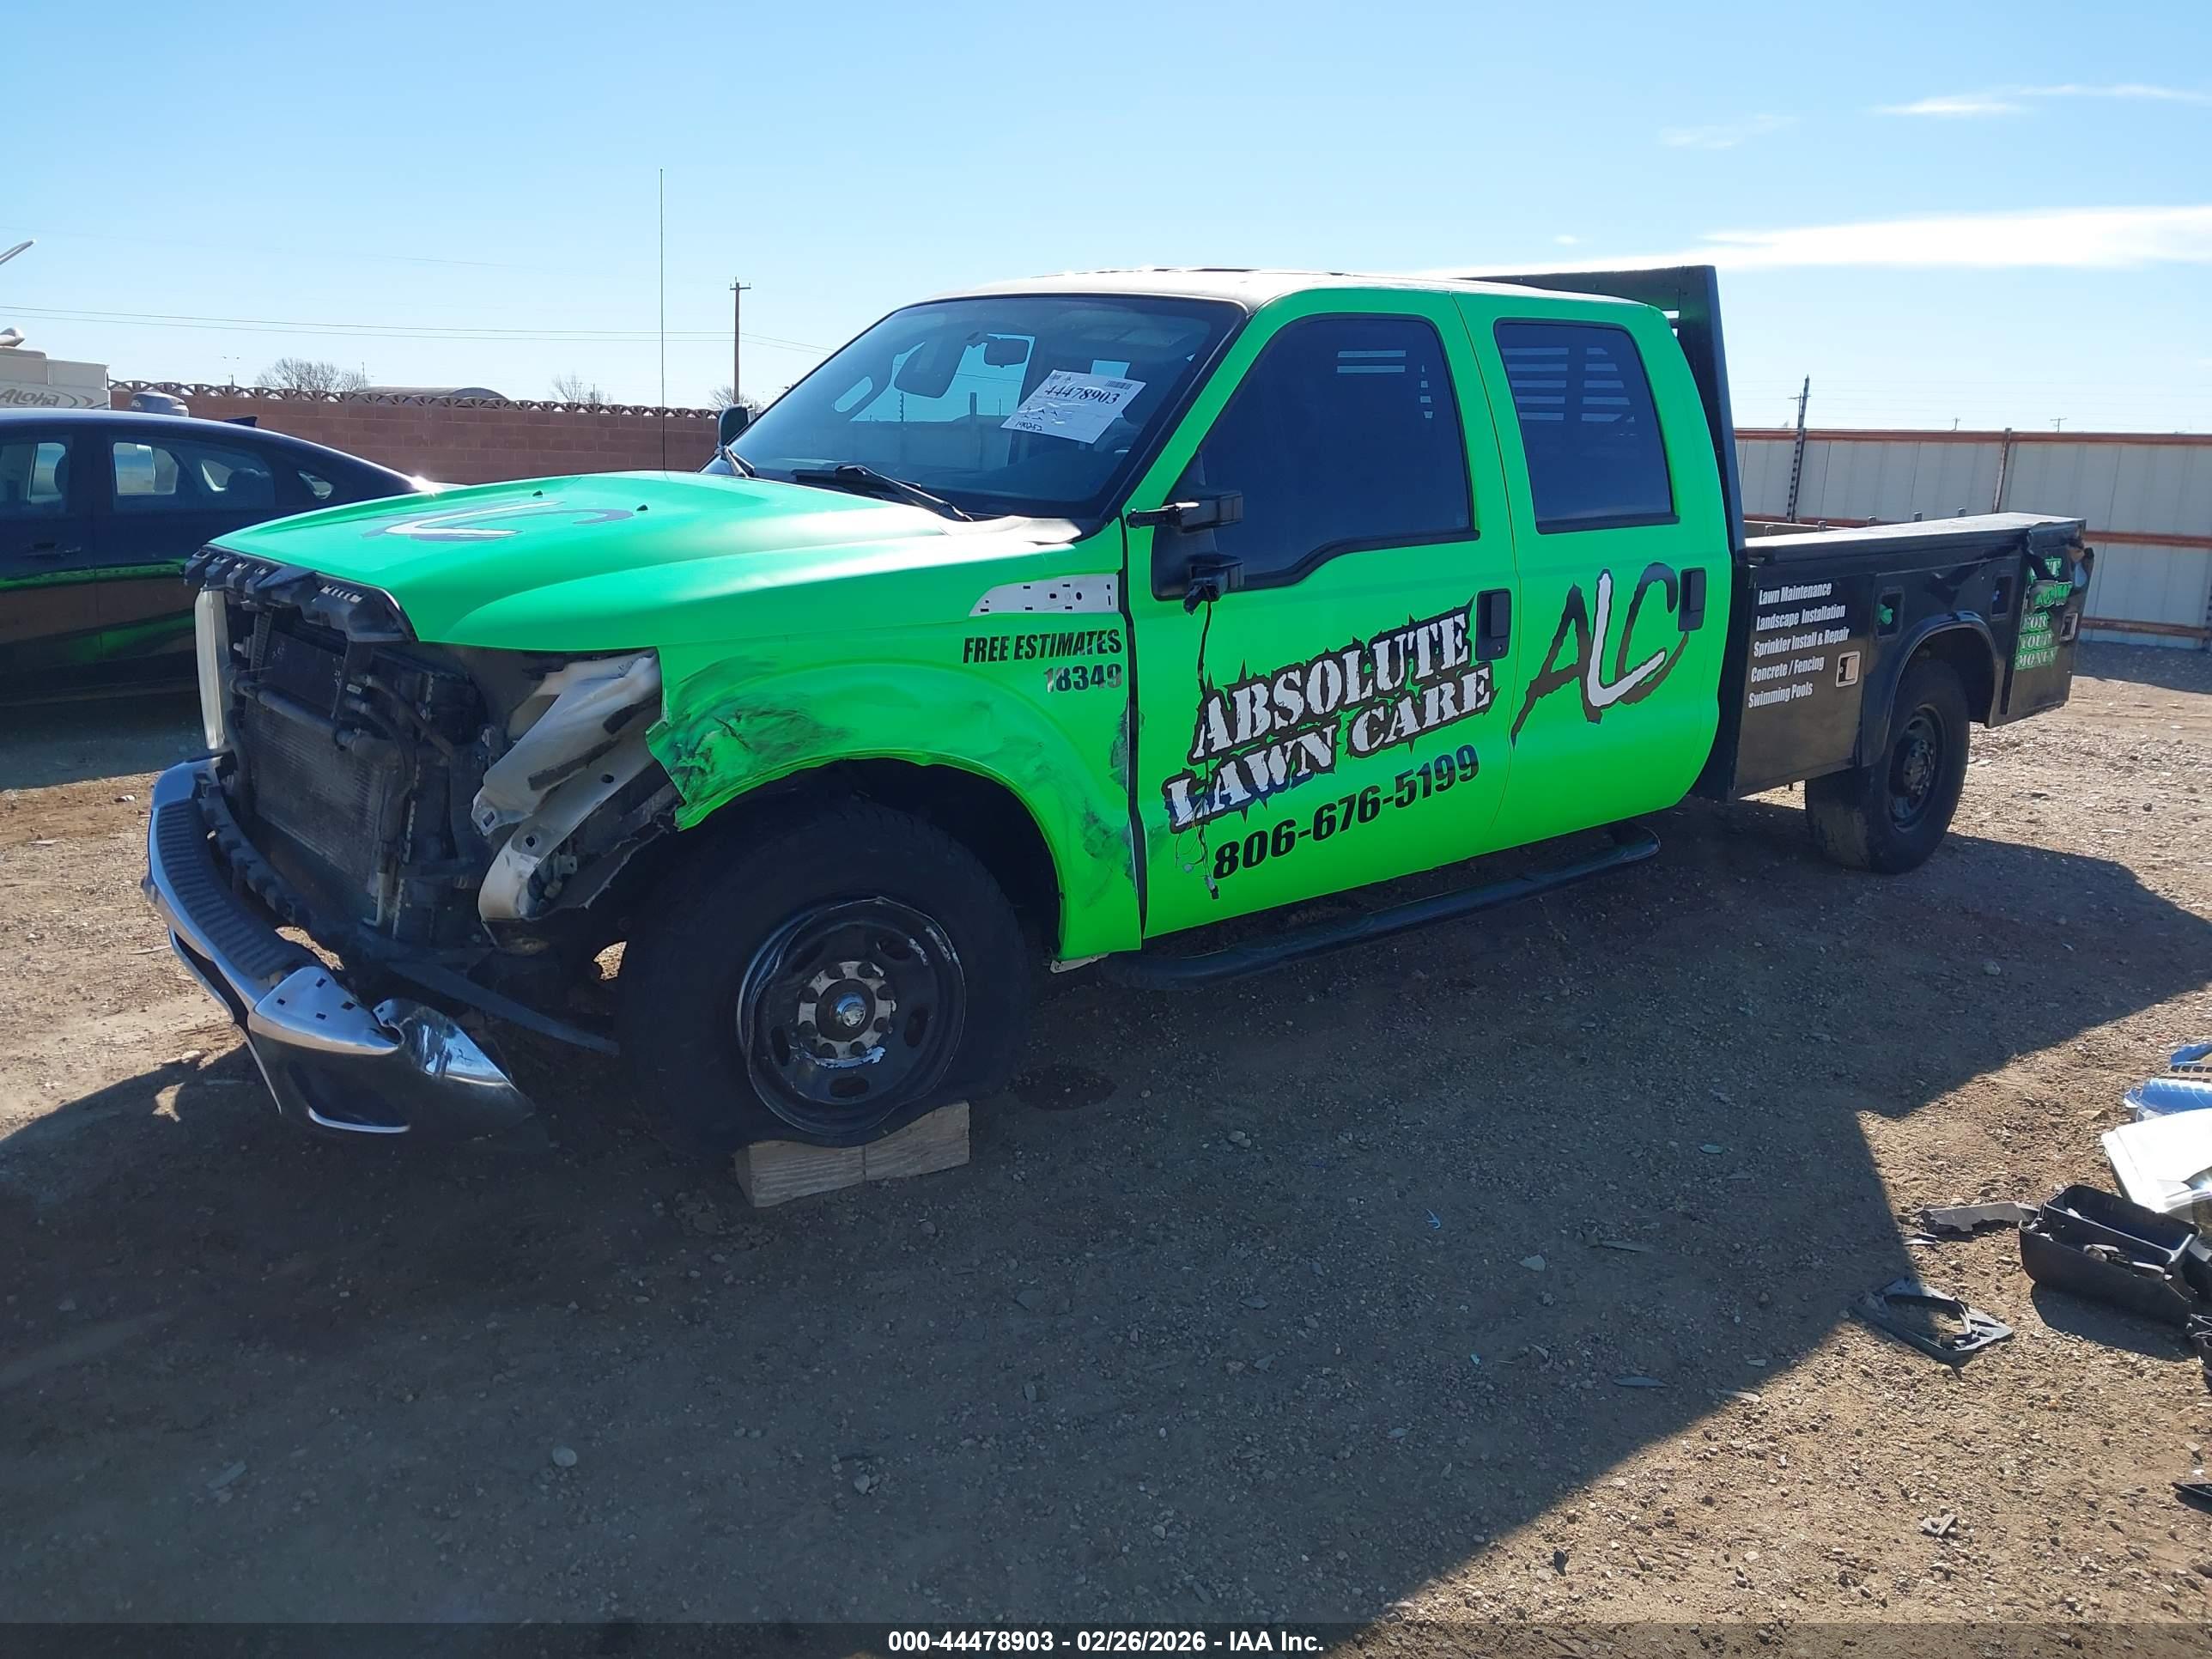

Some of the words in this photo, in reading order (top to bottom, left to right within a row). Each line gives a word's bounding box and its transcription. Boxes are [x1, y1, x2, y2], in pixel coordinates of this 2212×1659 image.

[1044, 386, 1120, 404] 44478903
[1759, 588, 1780, 605] Lawn
[1780, 582, 1832, 603] Maintenance
[1756, 612, 1800, 631] Landscape
[1802, 604, 1846, 623] Installation
[963, 635, 1010, 664] FREE
[1013, 629, 1122, 660] ESTIMATES
[1753, 638, 1791, 658] Sprinkler
[1791, 631, 1818, 650] Install
[1817, 633, 1824, 645] &
[1824, 626, 1850, 644] Repair
[1043, 664, 1121, 693] 18349
[1751, 665, 1788, 683] Concrete
[1788, 659, 1795, 676] /
[1794, 656, 1825, 674] Fencing
[1193, 613, 1469, 758] ABSOLUTE
[1748, 686, 1790, 708] Swimming
[1791, 681, 1814, 699] Pools
[1167, 725, 1336, 827] LAWN
[1350, 668, 1491, 752] CARE
[1212, 744, 1480, 879] 806-676-5199
